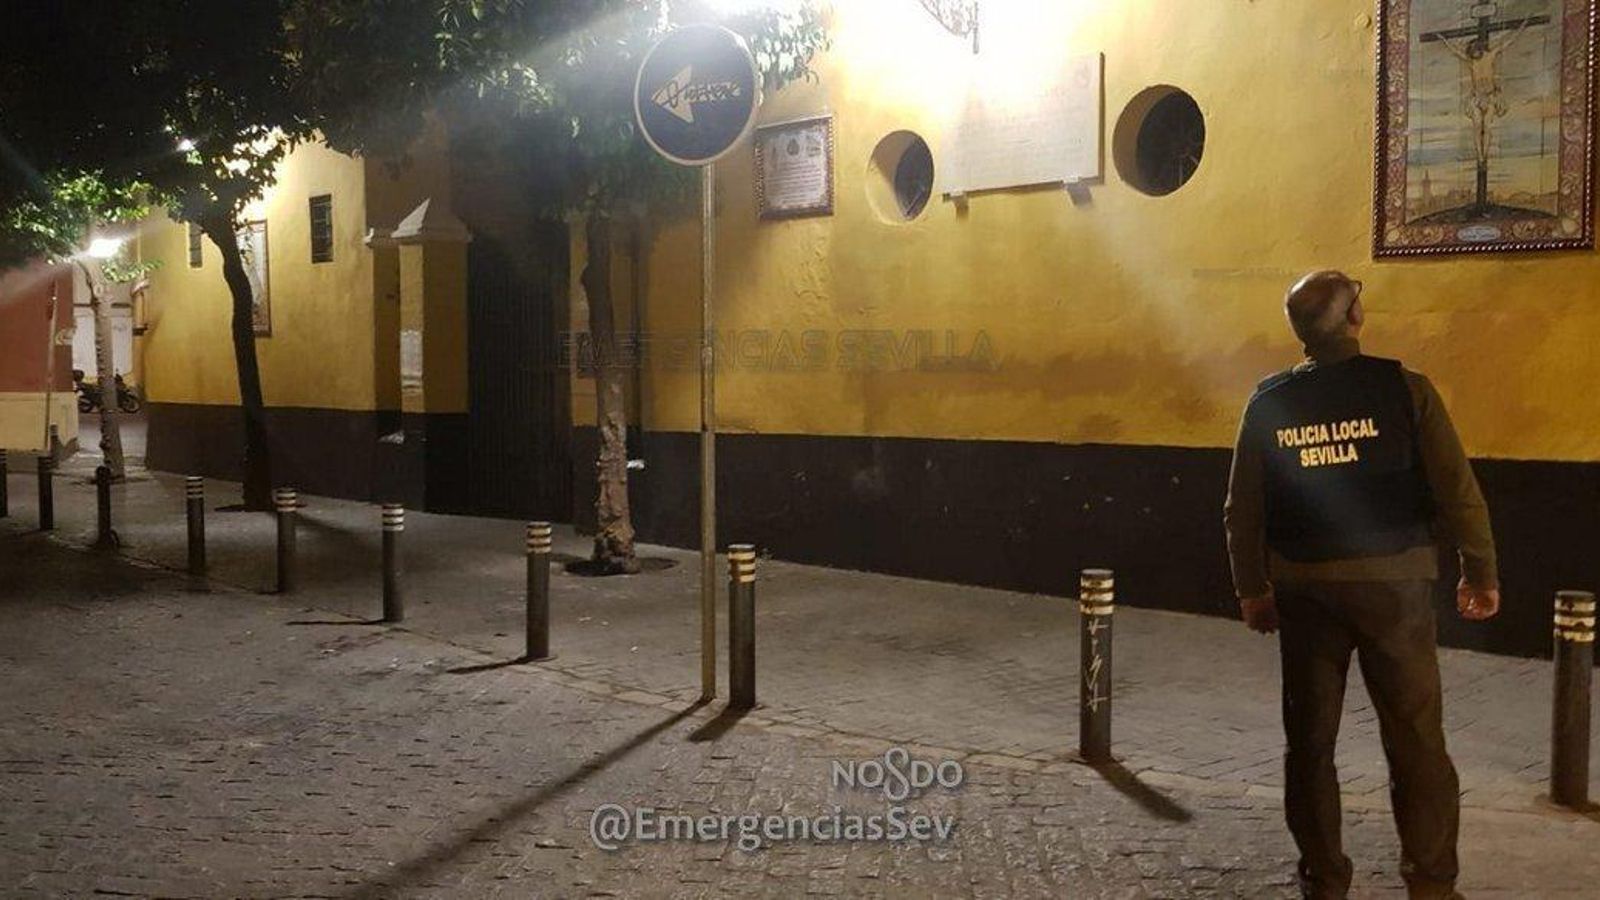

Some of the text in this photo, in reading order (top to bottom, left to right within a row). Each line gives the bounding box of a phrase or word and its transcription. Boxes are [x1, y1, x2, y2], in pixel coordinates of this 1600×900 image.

[1277, 418, 1379, 447] POLICIA LOCAL
[1300, 443, 1358, 467] SEVILLA
